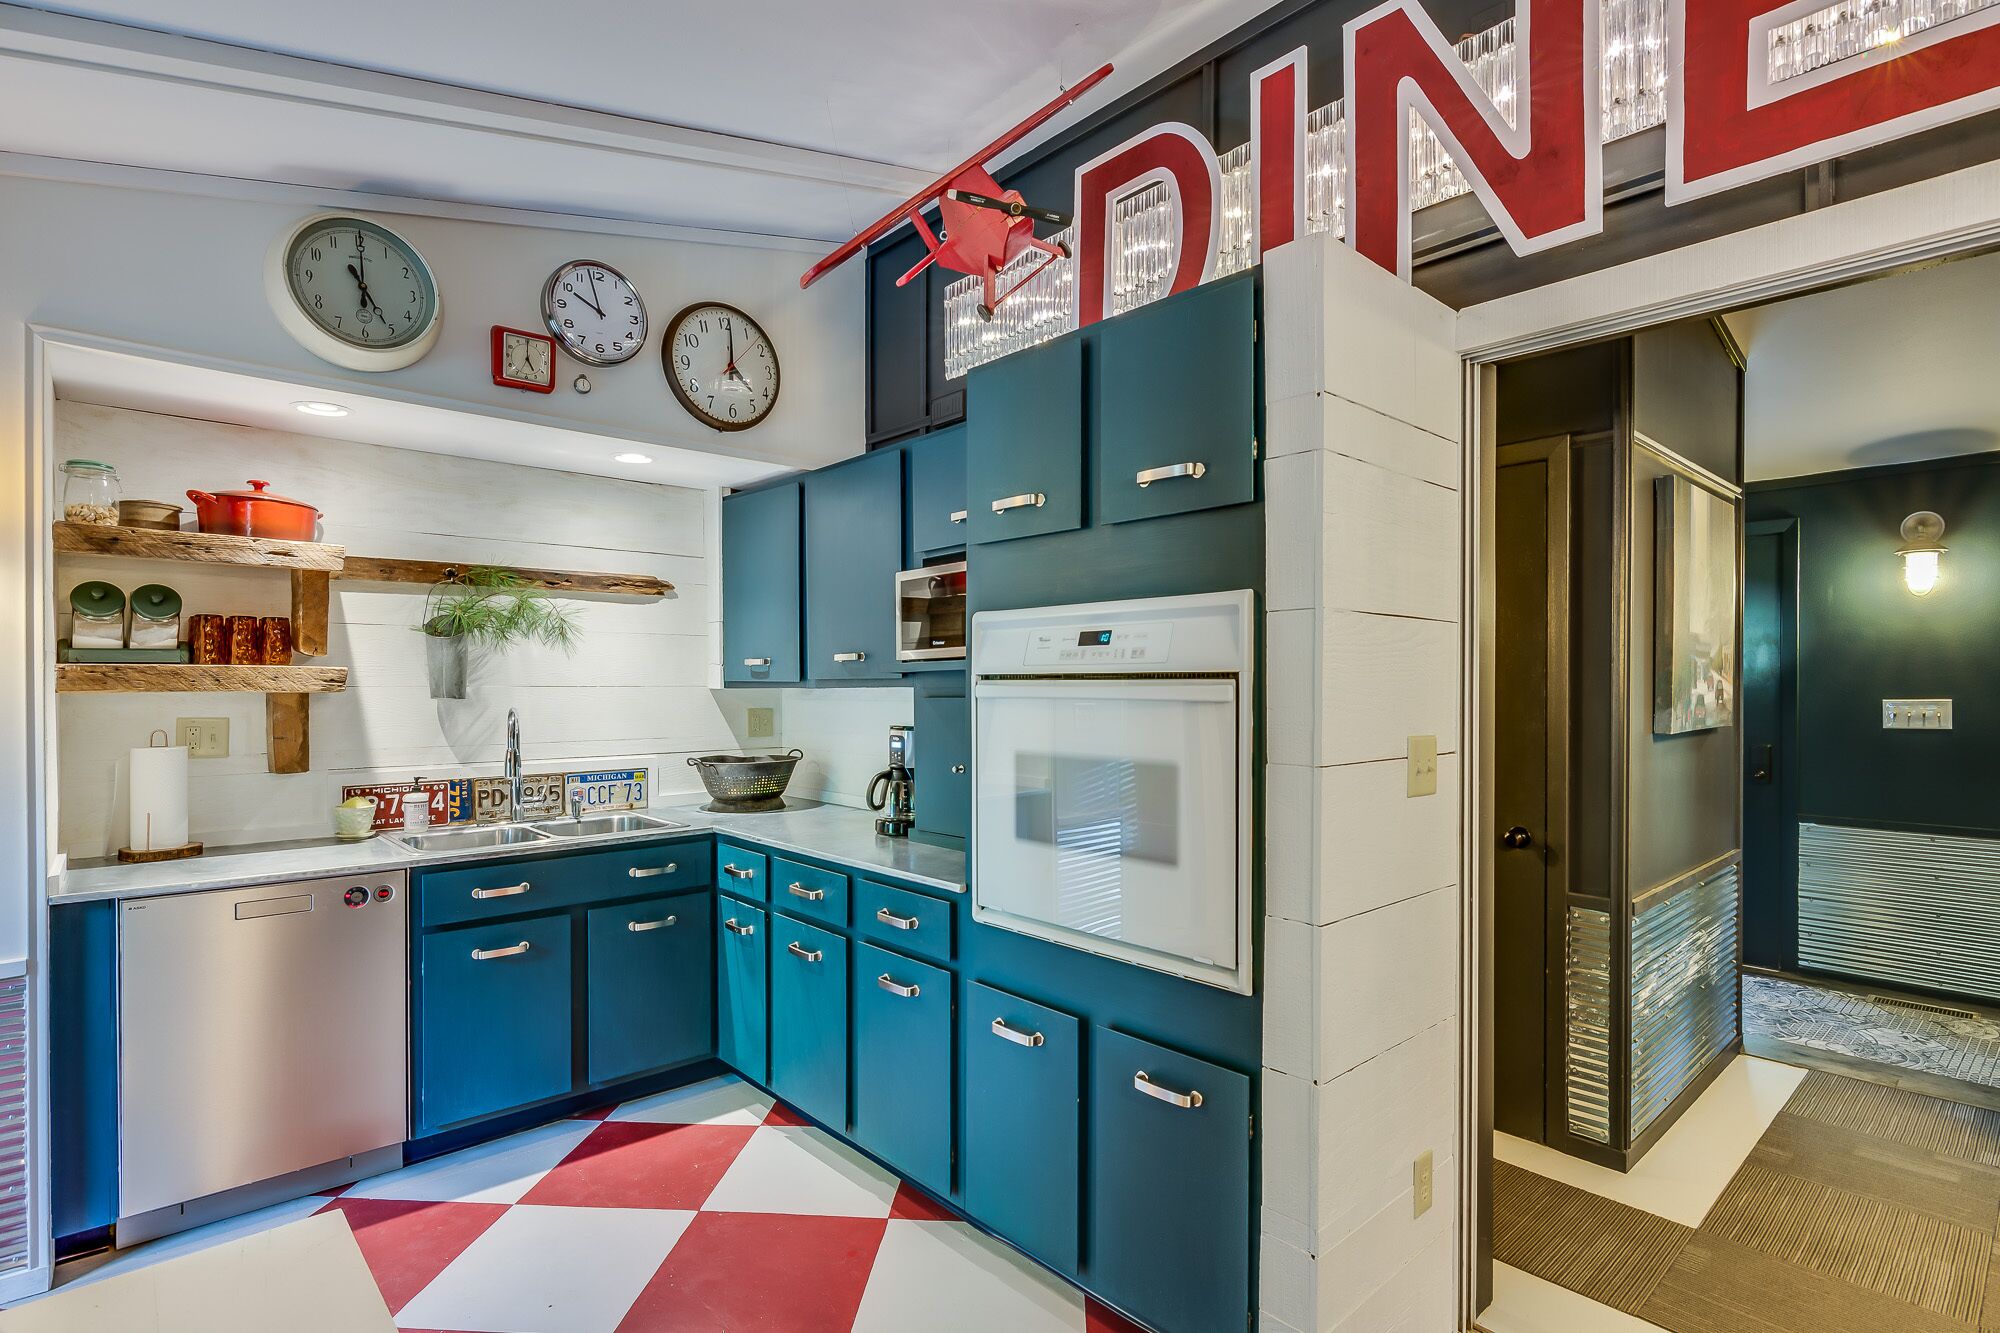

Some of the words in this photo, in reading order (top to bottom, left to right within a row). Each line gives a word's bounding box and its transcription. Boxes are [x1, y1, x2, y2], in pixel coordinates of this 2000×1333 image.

[329, 236, 337, 248] 11
[311, 247, 321, 261] 10
[384, 247, 387, 259] 1
[305, 269, 313, 283] 9
[402, 267, 409, 279] 2
[576, 273, 583, 283] 11
[593, 271, 604, 281] 12
[563, 282, 573, 292] 10
[614, 281, 617, 289] 1
[314, 294, 322, 309] 8
[409, 291, 416, 303] 3
[624, 297, 633, 306] 2
[557, 299, 567, 308] 9
[334, 316, 342, 328] 7
[404, 310, 412, 322] 4
[629, 315, 638, 325] 3
[564, 319, 574, 328] 8
[699, 320, 708, 333] 11
[718, 317, 731, 330] 12
[362, 325, 369, 338] 6
[388, 324, 395, 336] 5
[625, 332, 633, 340] 4
[744, 327, 748, 340] 1
[577, 335, 586, 344] 7
[683, 333, 699, 348] 10
[595, 344, 605, 353] 6
[613, 342, 623, 351] 5
[757, 344, 765, 357] 2
[680, 355, 690, 370] 9
[765, 366, 772, 380] 3
[690, 378, 699, 392] 8
[762, 387, 769, 400] 4
[707, 395, 715, 409] 7
[749, 399, 756, 413] 5
[729, 403, 737, 418] 6
[587, 773, 627, 781] MICHIGAN
[588, 784, 617, 805] CCF
[624, 782, 642, 802] 73
